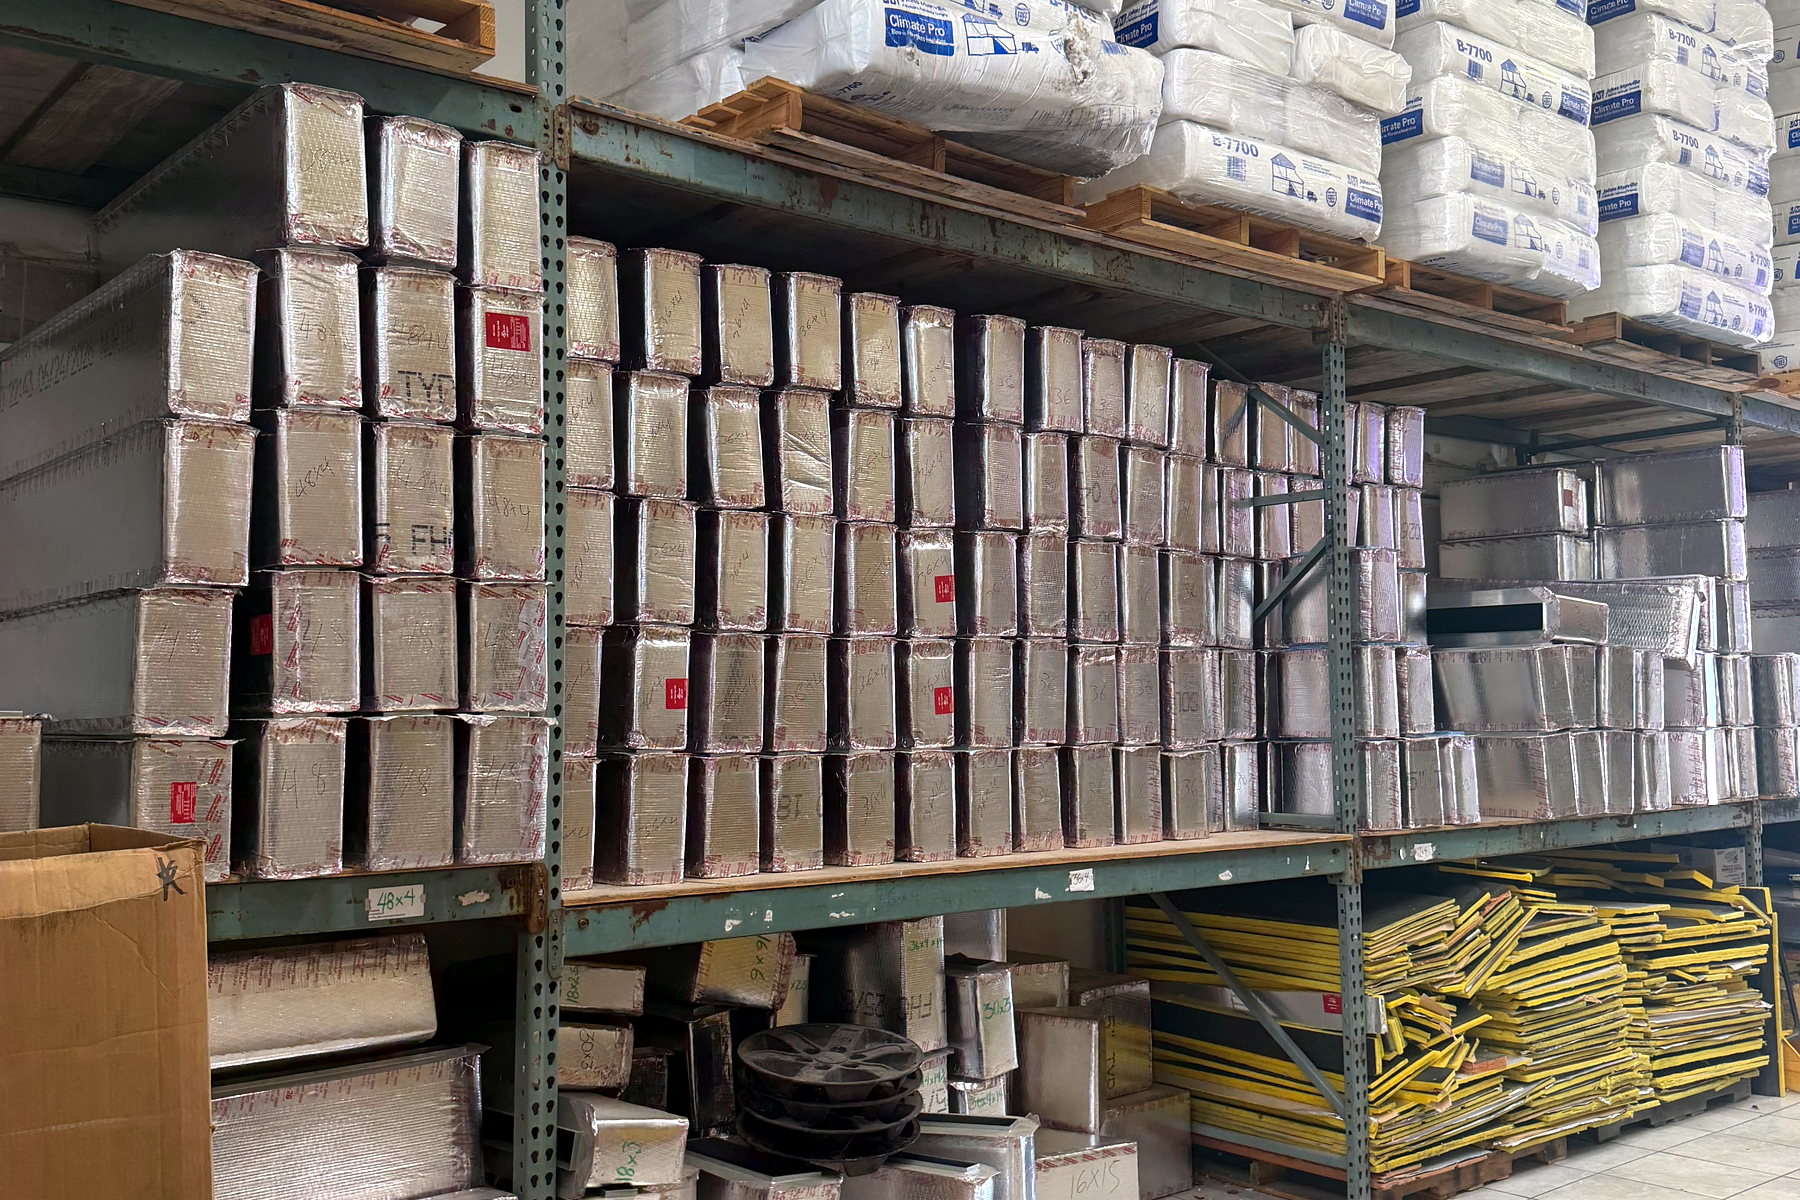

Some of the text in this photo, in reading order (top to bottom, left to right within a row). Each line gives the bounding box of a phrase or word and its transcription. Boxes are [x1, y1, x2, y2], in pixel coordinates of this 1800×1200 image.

[1590, 2, 1615, 15] Climate
[889, 14, 946, 37] Climate Pro
[1140, 22, 1153, 34] Pro
[1668, 29, 1696, 49] B-7700
[1456, 38, 1493, 63] B-7700
[1594, 97, 1634, 115] Climate Pro
[1402, 116, 1417, 130] Pro
[1211, 134, 1259, 158] B-7700
[1672, 129, 1699, 149] B-7700
[1350, 192, 1374, 208] Climate
[1600, 198, 1632, 214] mate Pro
[800, 307, 828, 338] 36x4
[1055, 388, 1072, 406] 36
[721, 431, 750, 445] 36x4
[295, 456, 336, 498] 48x4
[728, 550, 750, 581] 36x4
[917, 556, 949, 587] 36x4
[858, 662, 888, 695] 36x4
[1090, 684, 1109, 701] 36
[281, 762, 327, 809] 48
[1182, 777, 1198, 798] 36
[1071, 871, 1091, 888] 36x4
[376, 888, 416, 915] 48x4
[579, 1028, 595, 1070] 30x3
[614, 1141, 642, 1182] 18x3
